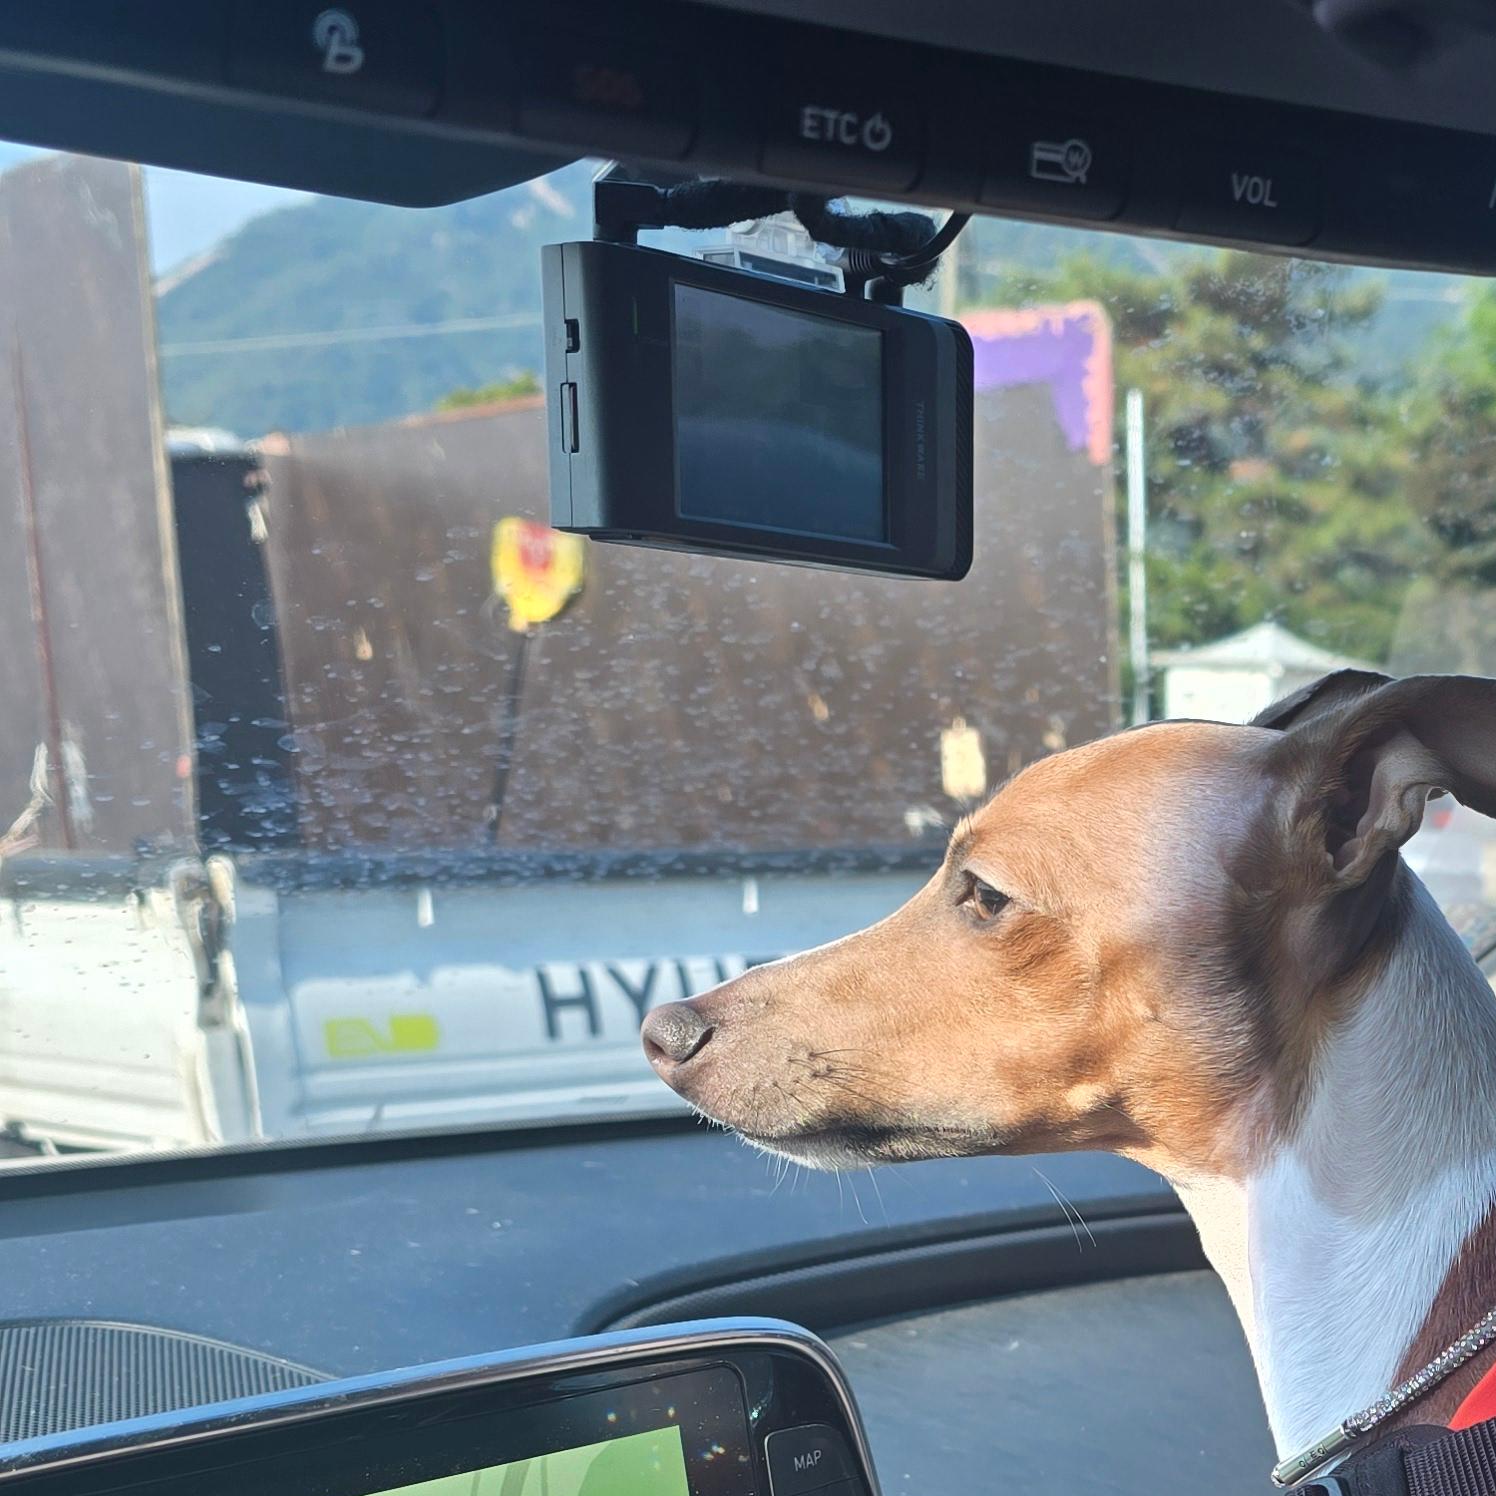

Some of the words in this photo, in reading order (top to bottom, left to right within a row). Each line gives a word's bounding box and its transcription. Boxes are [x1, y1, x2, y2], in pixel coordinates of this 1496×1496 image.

[803, 106, 858, 144] ETC
[1232, 172, 1277, 207] VOL
[794, 1449, 823, 1472] MAP
